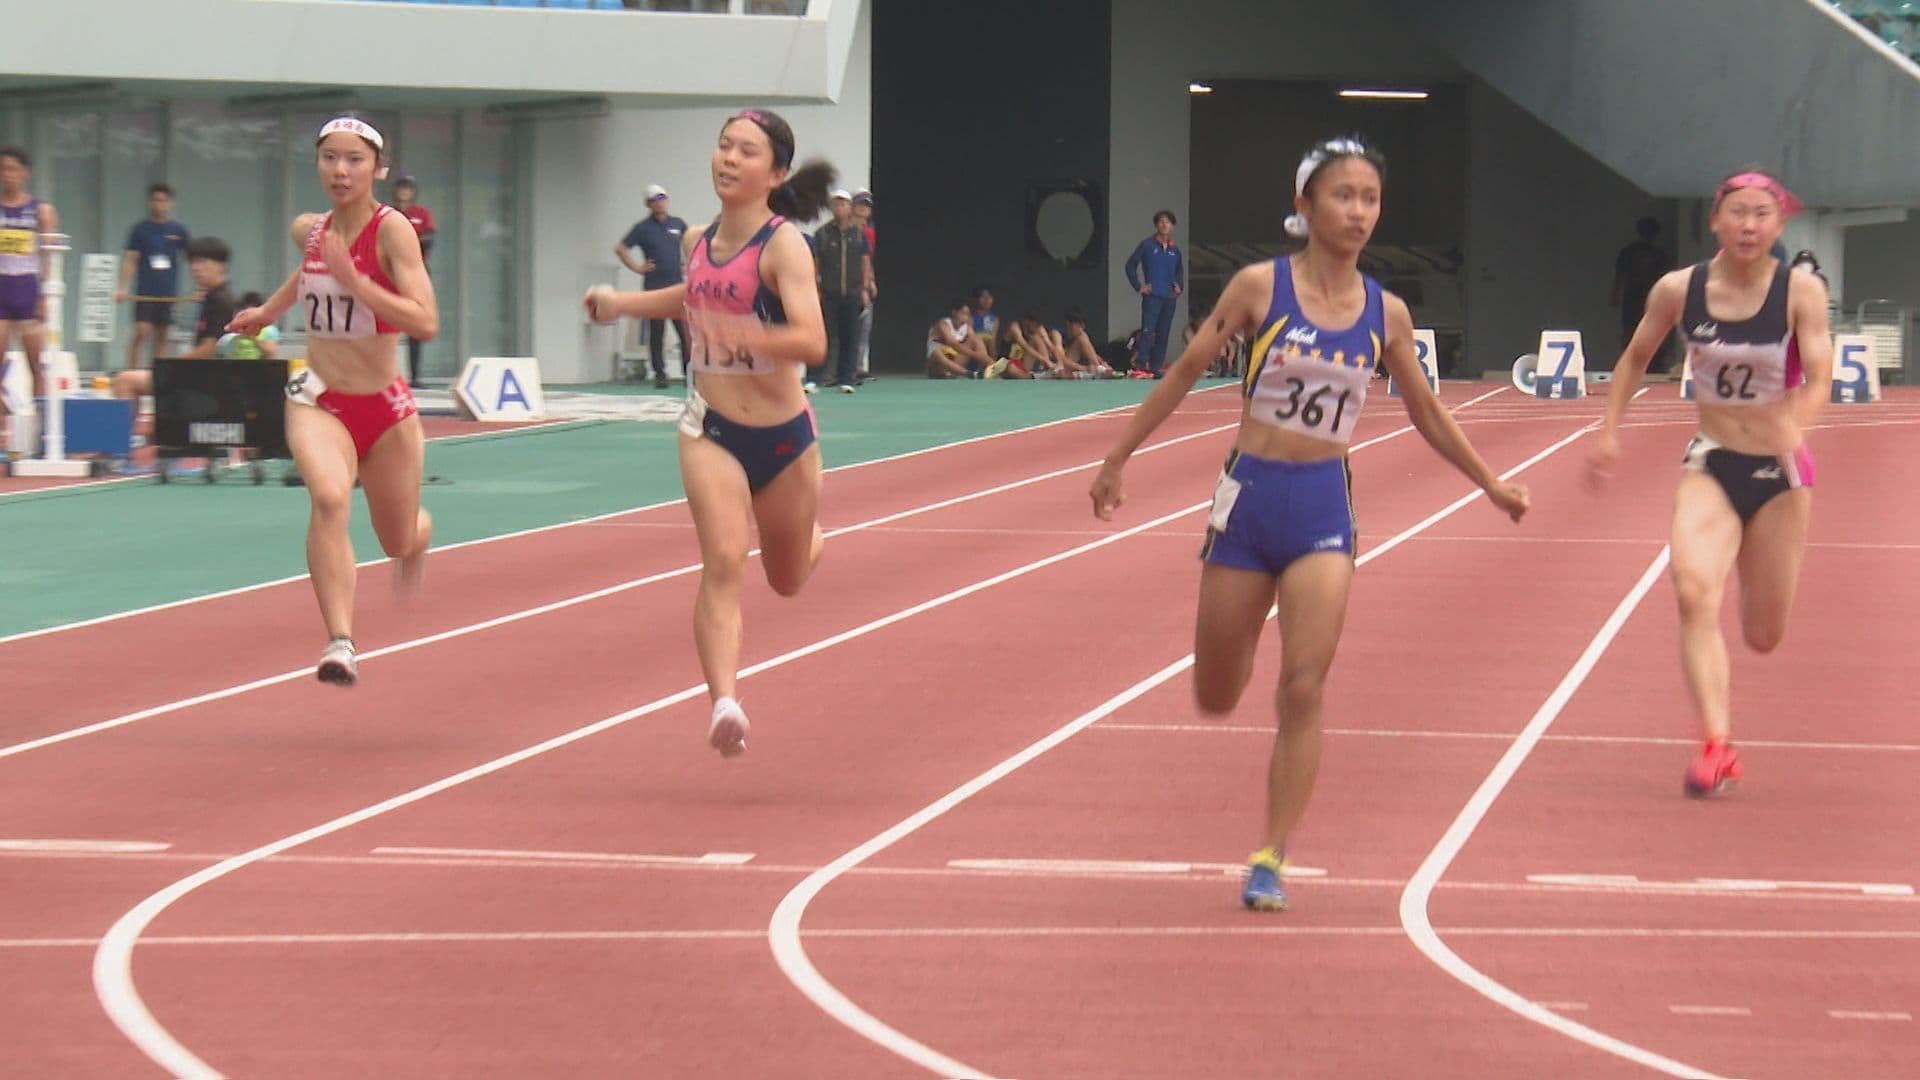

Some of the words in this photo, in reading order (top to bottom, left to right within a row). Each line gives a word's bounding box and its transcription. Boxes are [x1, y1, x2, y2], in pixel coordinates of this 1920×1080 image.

[305, 293, 354, 332] 217
[1547, 341, 1575, 384] 7
[1716, 364, 1757, 399] 62
[1841, 344, 1868, 383] 5
[496, 368, 532, 412] A
[1275, 377, 1351, 433] 361
